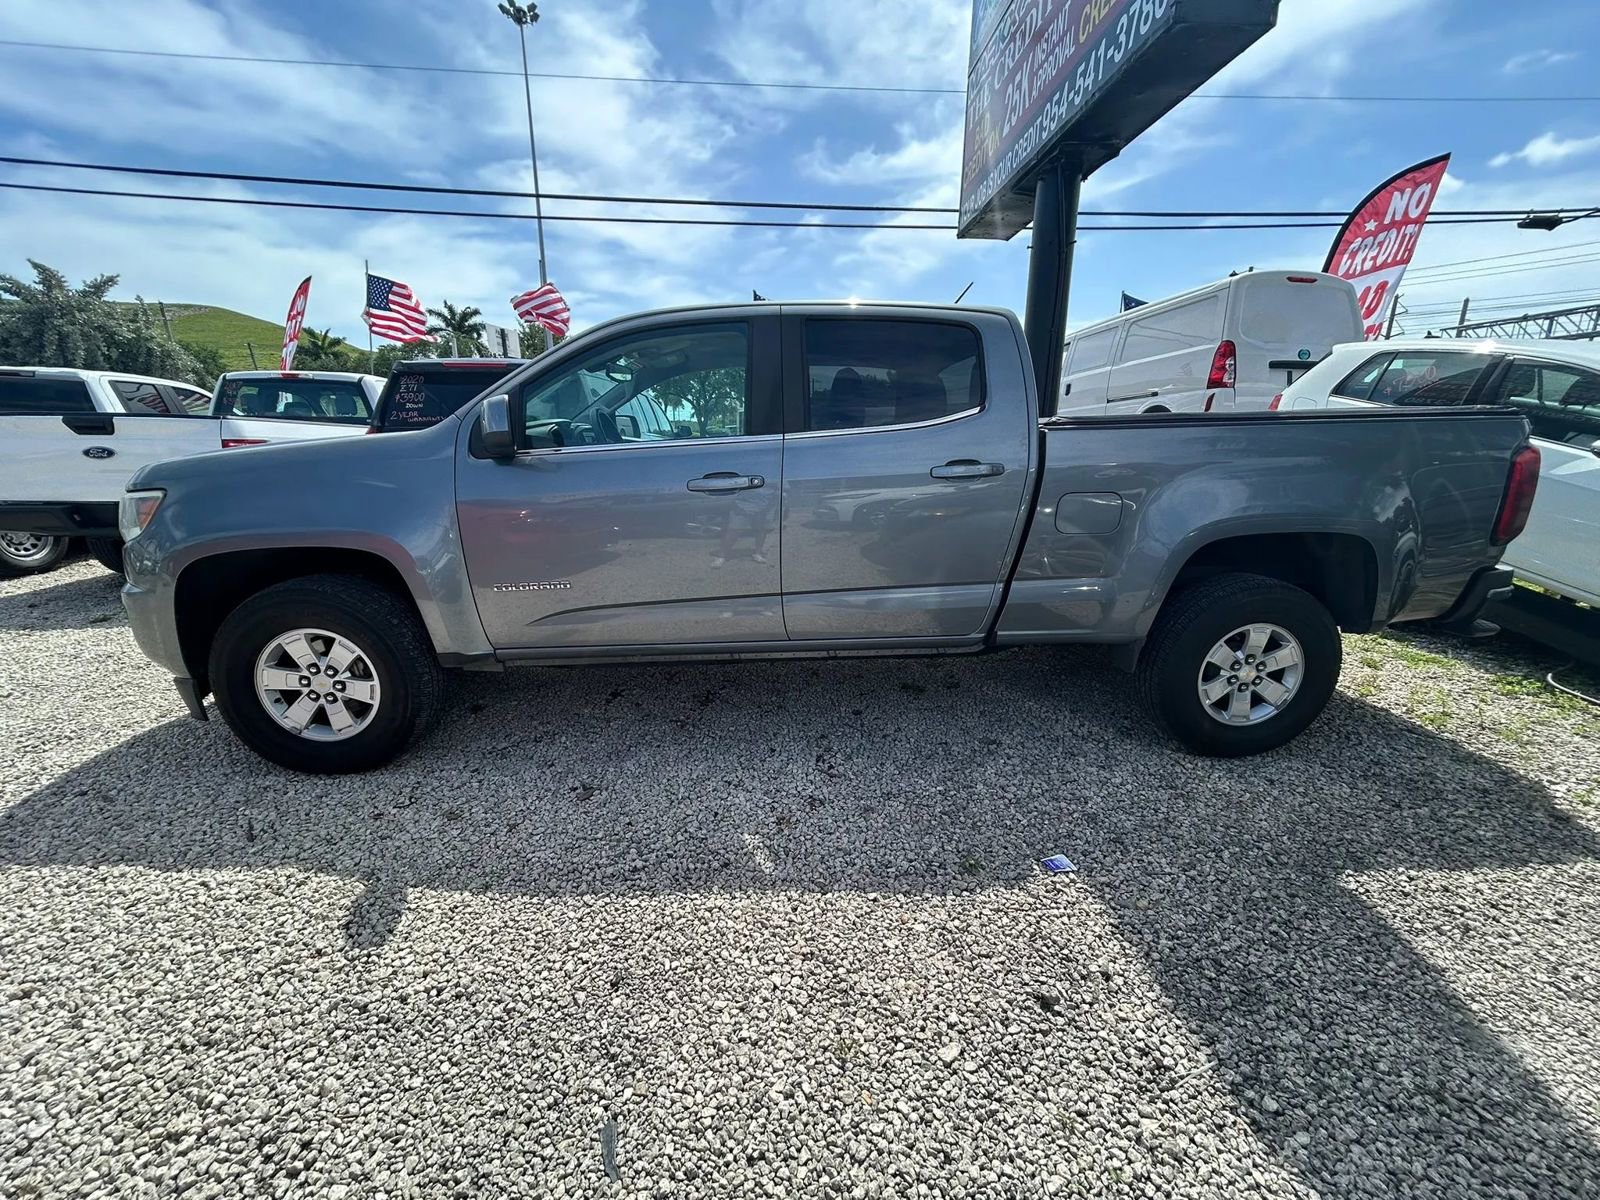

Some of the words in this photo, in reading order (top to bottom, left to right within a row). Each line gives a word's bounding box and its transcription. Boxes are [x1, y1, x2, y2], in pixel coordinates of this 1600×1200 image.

[1030, 25, 1076, 104] APPROVAL
[1033, 0, 1072, 73] INSTANT
[967, 75, 993, 131] THE
[1002, 51, 1034, 138] 25K
[993, 151, 1012, 189] YOUR
[1012, 115, 1042, 169] CREDIT
[1384, 182, 1432, 225] NO
[400, 375, 424, 384] 2020
[390, 410, 398, 420] 2
[493, 581, 571, 592] COLORADO
